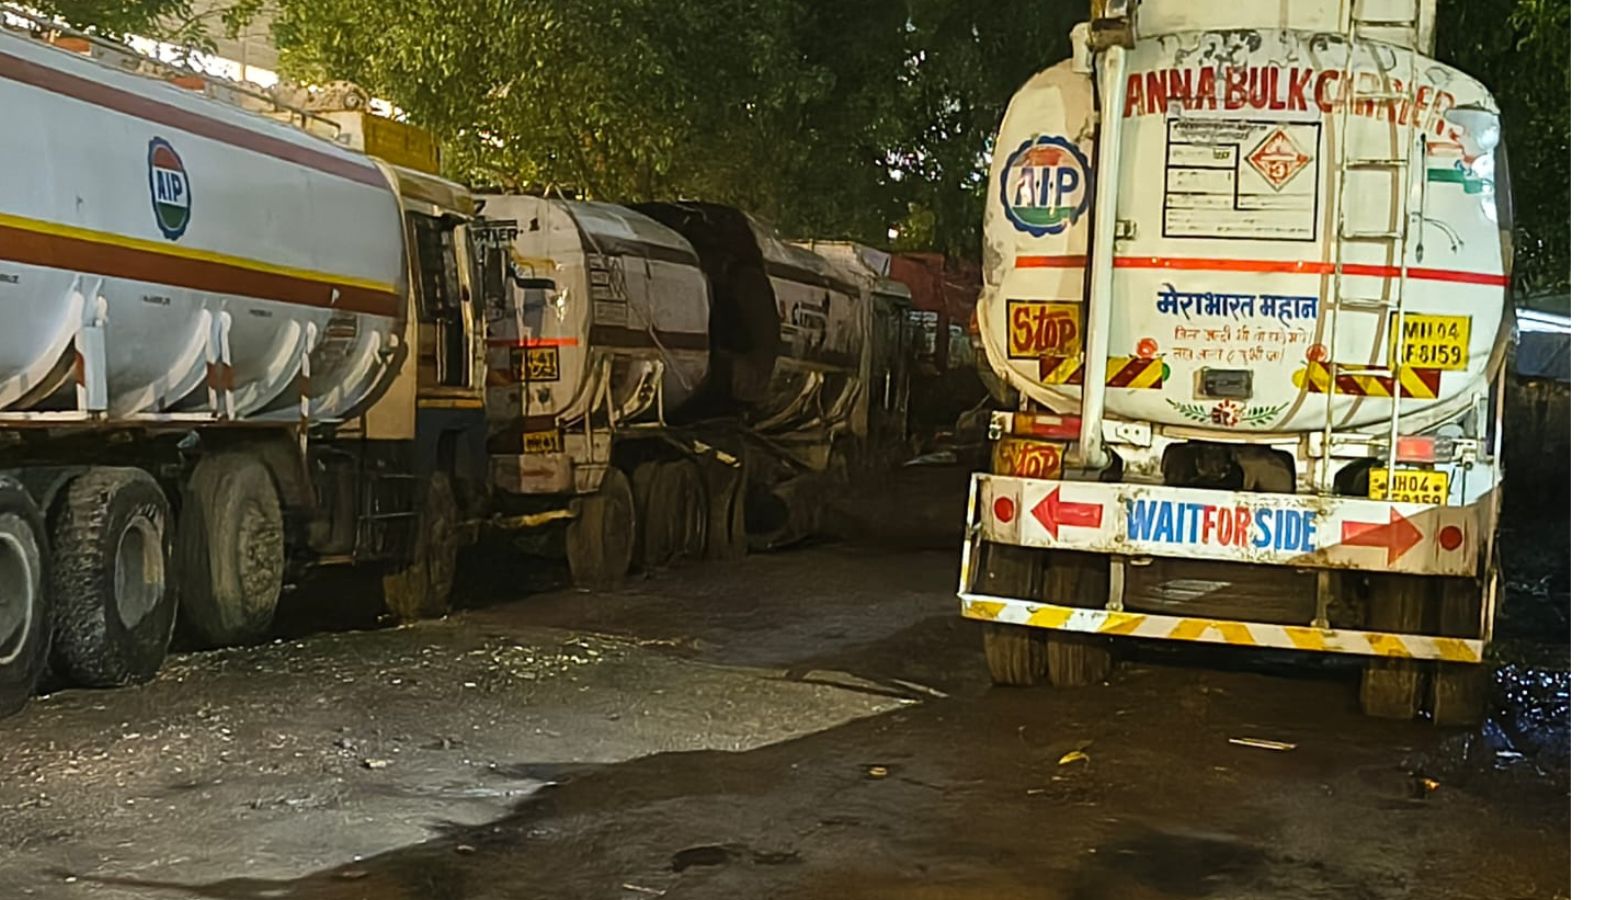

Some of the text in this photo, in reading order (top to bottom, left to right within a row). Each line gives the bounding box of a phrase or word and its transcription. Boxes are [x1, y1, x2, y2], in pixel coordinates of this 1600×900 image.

[1123, 67, 1217, 118] ANNA
[1224, 66, 1313, 111] BULK
[156, 169, 183, 202] AIP
[1259, 295, 1318, 327] महान
[1126, 498, 1317, 552] WAIT FOR SIDE
